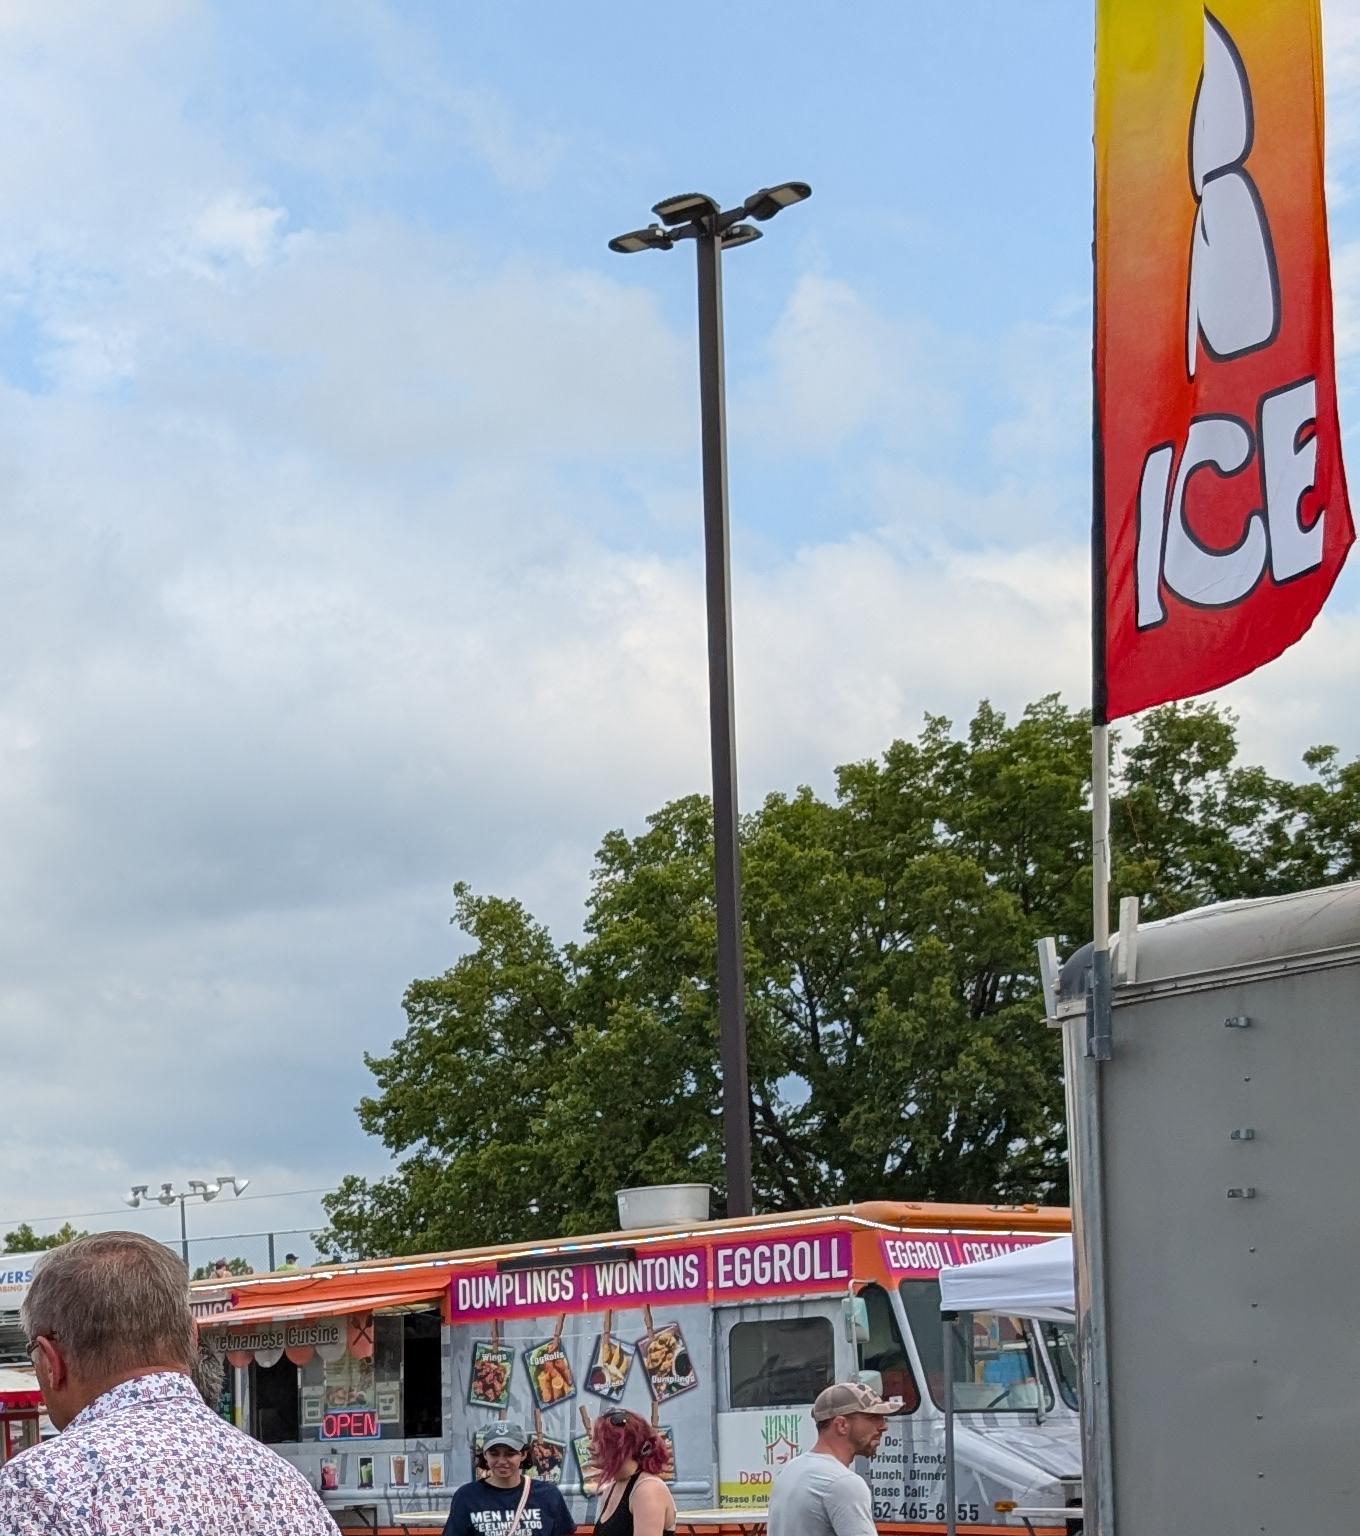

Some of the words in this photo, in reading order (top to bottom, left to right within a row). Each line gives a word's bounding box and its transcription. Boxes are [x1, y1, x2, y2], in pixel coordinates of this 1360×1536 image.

[1135, 374, 1324, 632] ICE
[718, 1237, 849, 1288] EGGROLL
[884, 1239, 955, 1270] EGGROLL
[595, 1253, 700, 1297] WONTONS
[458, 1267, 575, 1313] DUMPLINGS
[287, 1325, 339, 1347] Cuisine
[481, 1352, 508, 1363] Wings
[651, 1374, 696, 1385] Dumplings
[322, 1412, 378, 1438] OPEN
[739, 1470, 773, 1485] D&D
[871, 1486, 901, 1498] lease
[904, 1485, 929, 1498] Call:
[470, 1510, 502, 1524] MEN
[873, 1501, 979, 1522] 52-465-855
[525, 1520, 542, 1529] TOO
